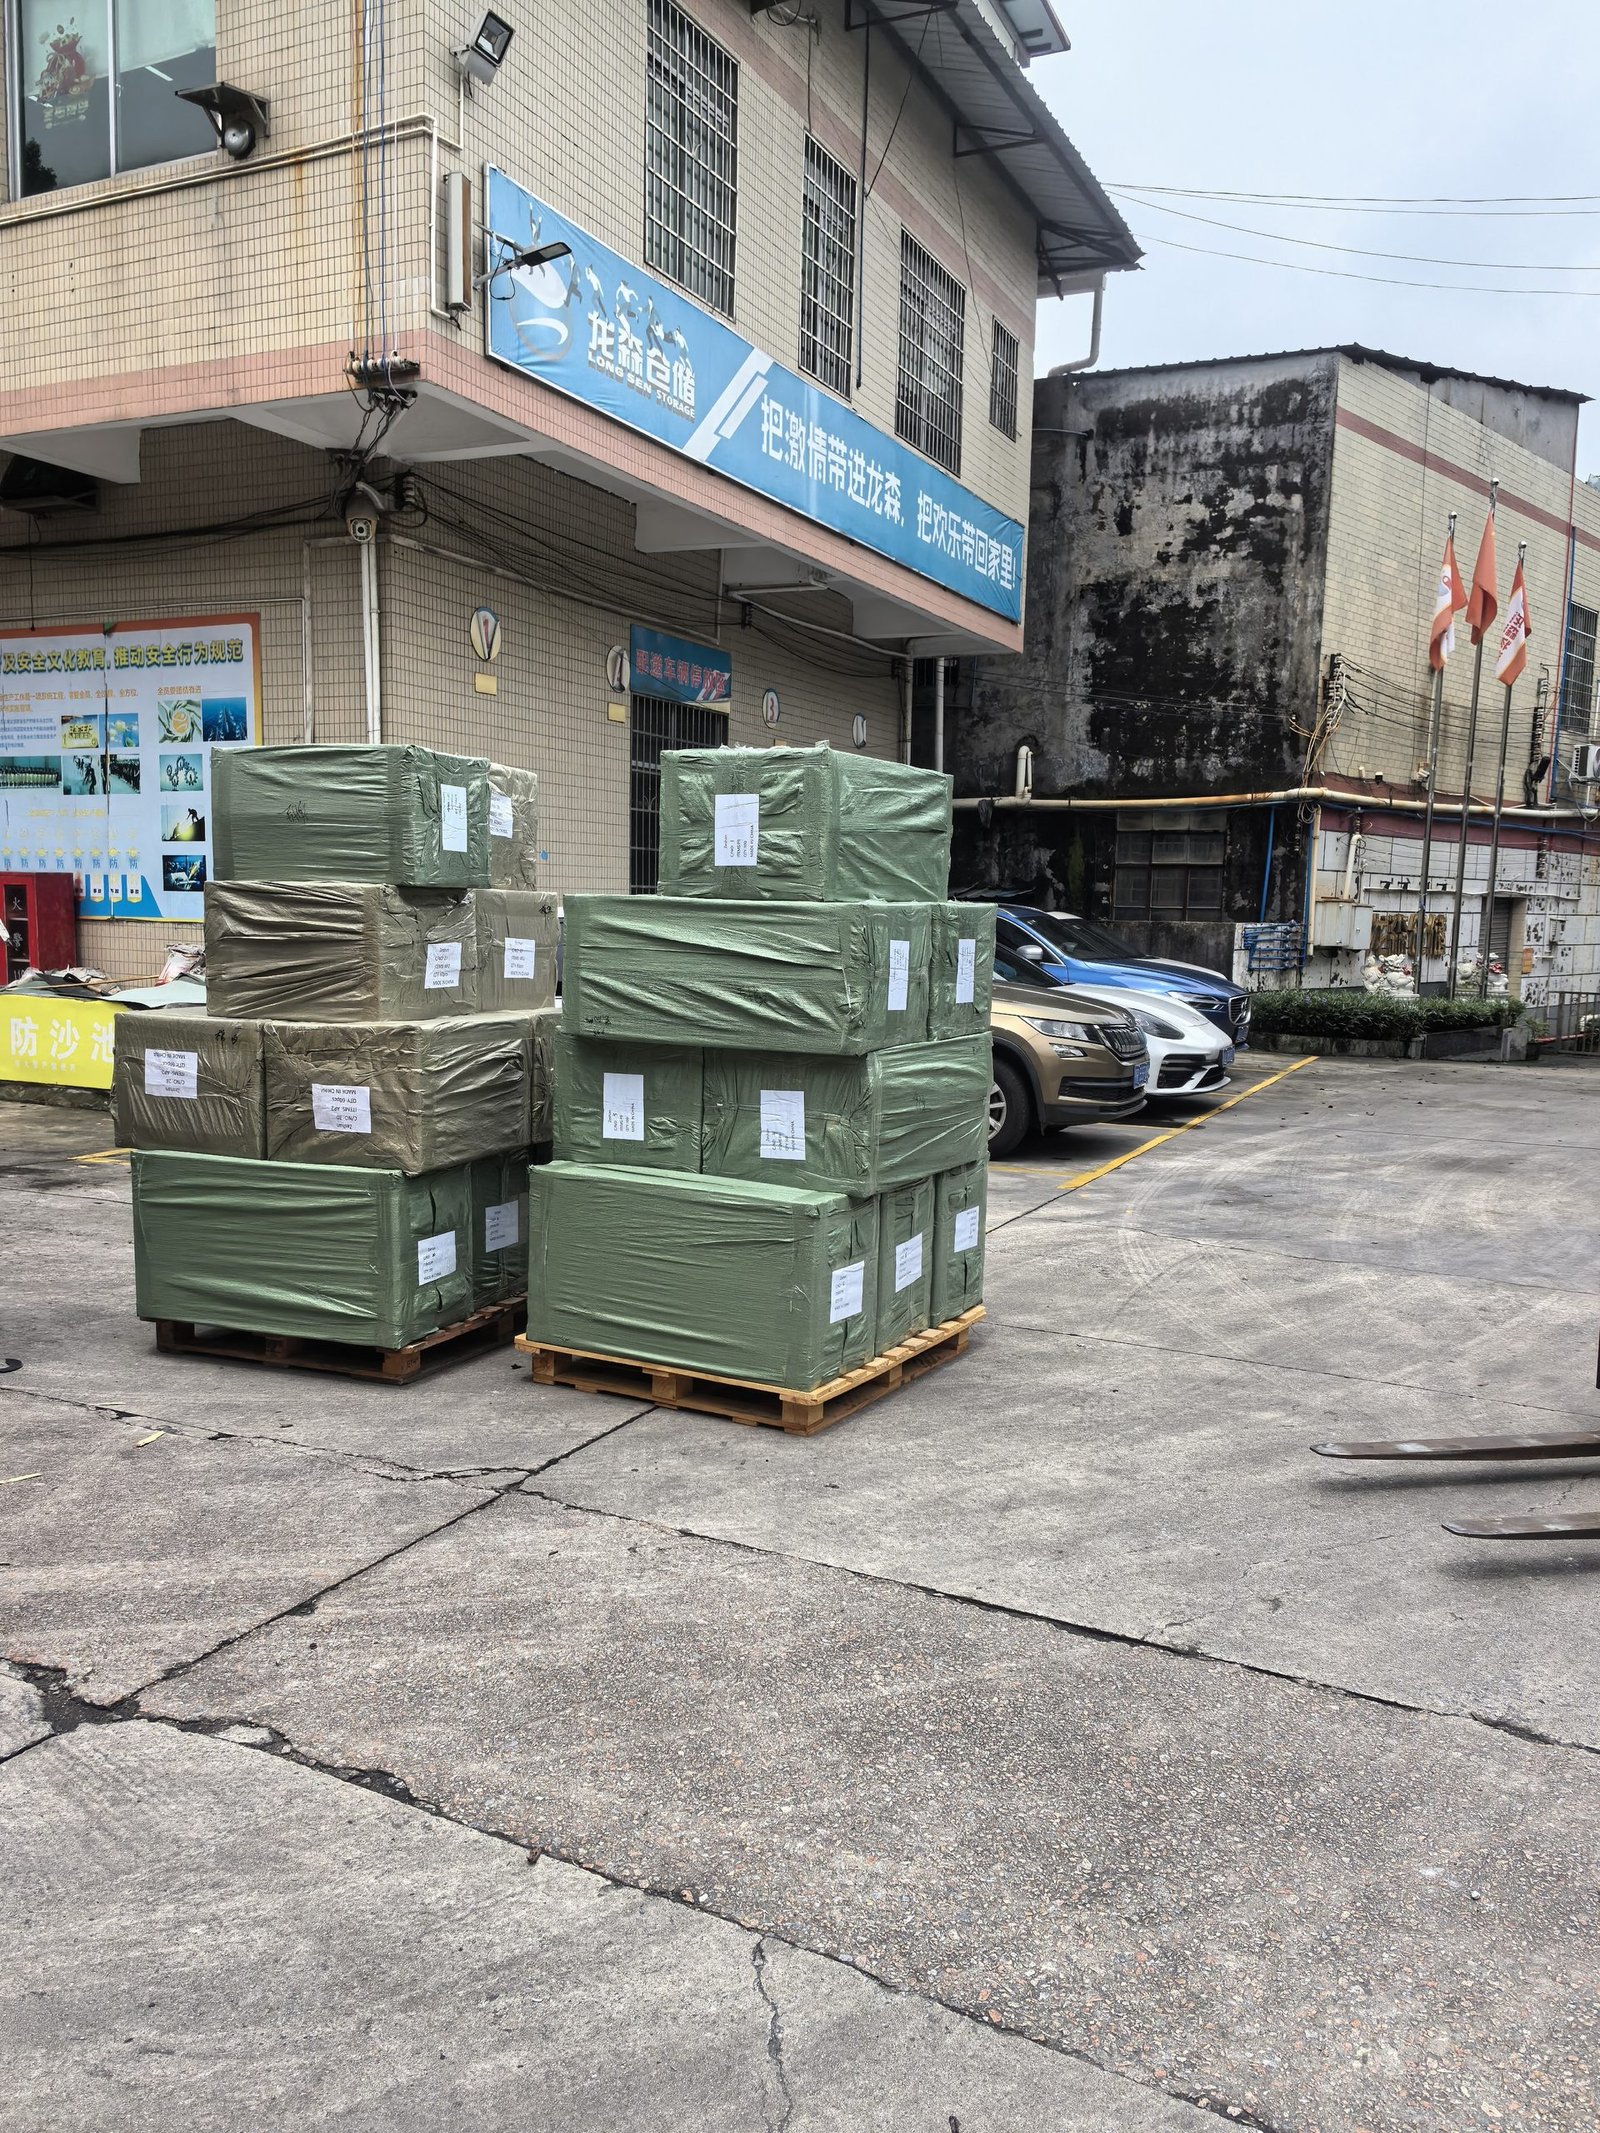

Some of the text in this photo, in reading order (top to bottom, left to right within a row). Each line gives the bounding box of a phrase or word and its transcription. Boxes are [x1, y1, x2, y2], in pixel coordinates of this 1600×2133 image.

[588, 350, 695, 418] LONG SEN STORAGE
[10, 1016, 115, 1063] 防沙池
